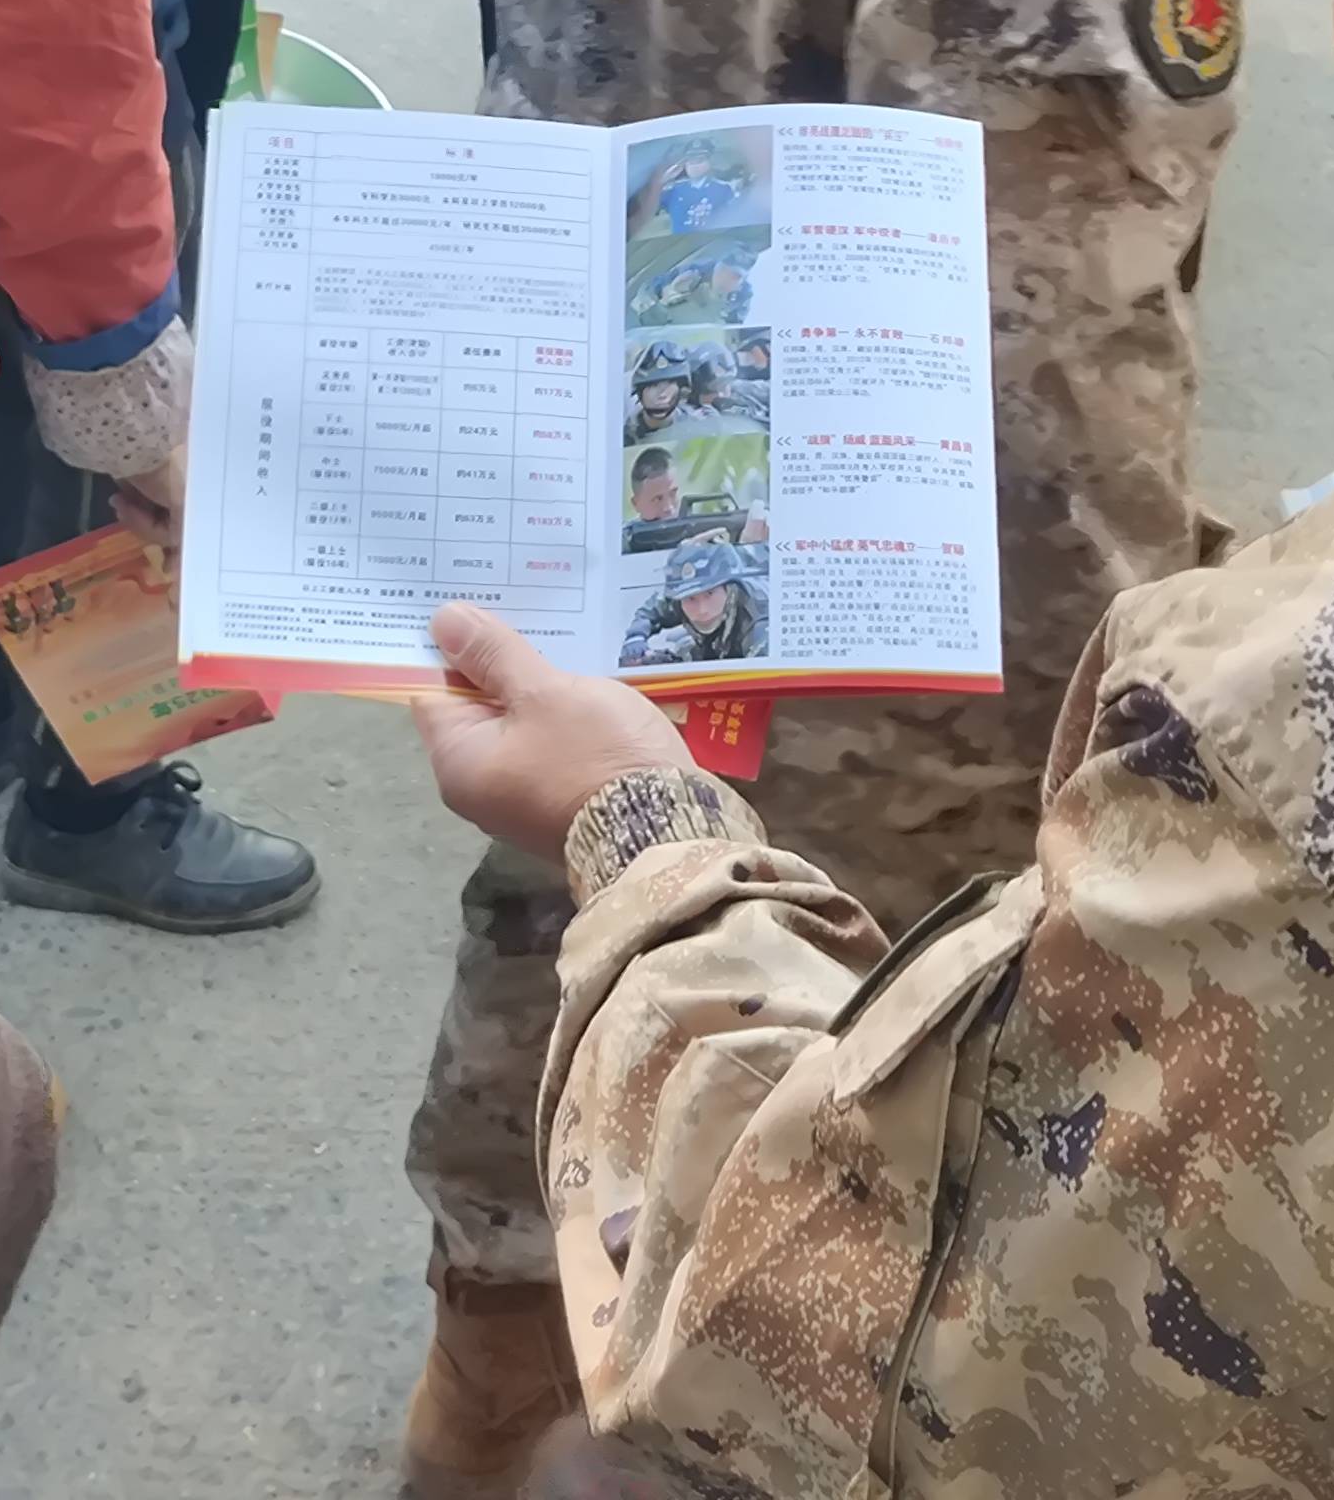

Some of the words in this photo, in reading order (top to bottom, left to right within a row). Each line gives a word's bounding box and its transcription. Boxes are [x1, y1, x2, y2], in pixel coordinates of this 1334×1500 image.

[268, 136, 295, 149] 项目
[800, 327, 850, 339] 勇争第一
[458, 424, 499, 437] 约24万元
[456, 468, 497, 481] 约41万元
